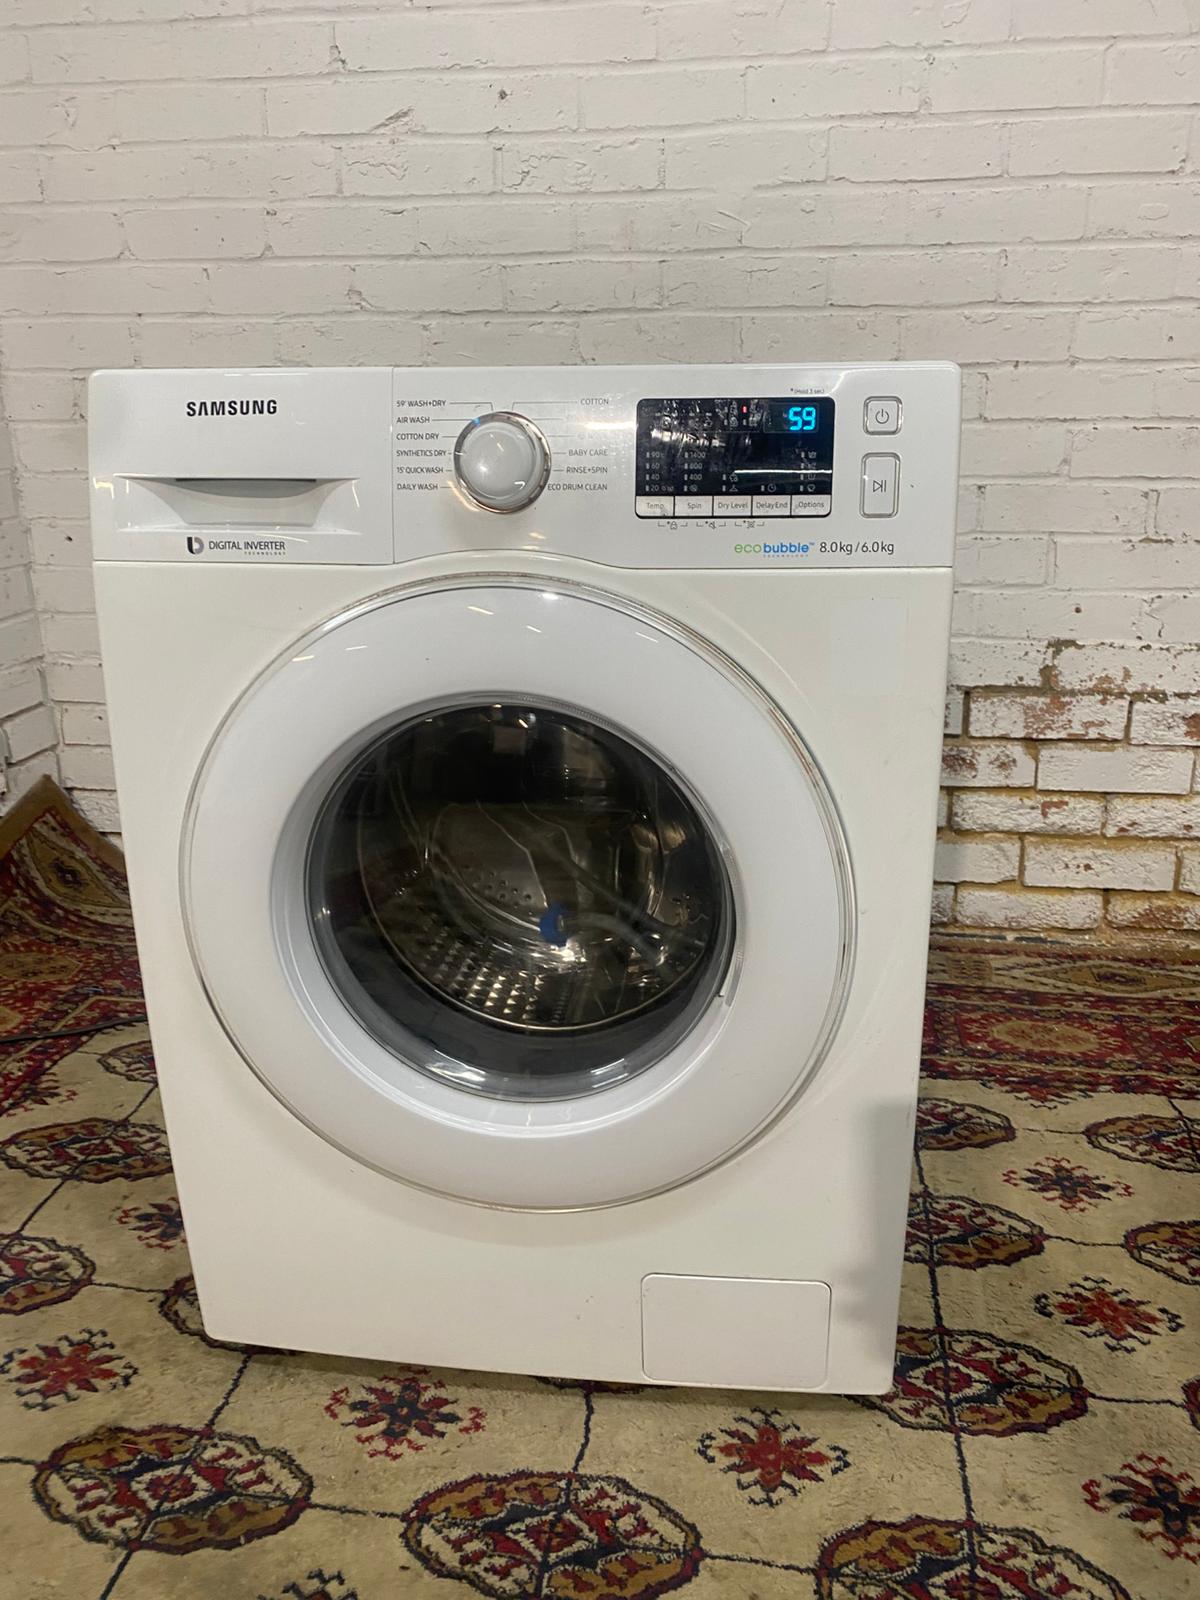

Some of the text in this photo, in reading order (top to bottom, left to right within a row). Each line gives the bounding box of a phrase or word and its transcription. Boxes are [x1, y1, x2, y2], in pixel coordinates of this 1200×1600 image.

[407, 399, 446, 408] WASH+DRY
[580, 397, 609, 406] COTTON
[186, 399, 278, 416] SAMSUNG
[396, 415, 430, 424] AIR WASH
[788, 406, 817, 431] 59
[396, 432, 439, 441] COTTON DRY
[396, 449, 447, 457] SYNTHETICS DRY
[568, 448, 609, 457] BABY CARE
[407, 466, 425, 474] QUICK
[425, 466, 444, 474] WASH
[566, 466, 608, 474] RINSE+SPIN
[396, 483, 438, 491] DAILY WASH
[547, 483, 608, 491] ECO DRUM CLEAN
[687, 501, 702, 510] Spin
[717, 501, 749, 510] Dry Level
[755, 501, 788, 510] Delay End
[798, 500, 825, 510] Options
[208, 540, 286, 551] DIGITAL INVERTER
